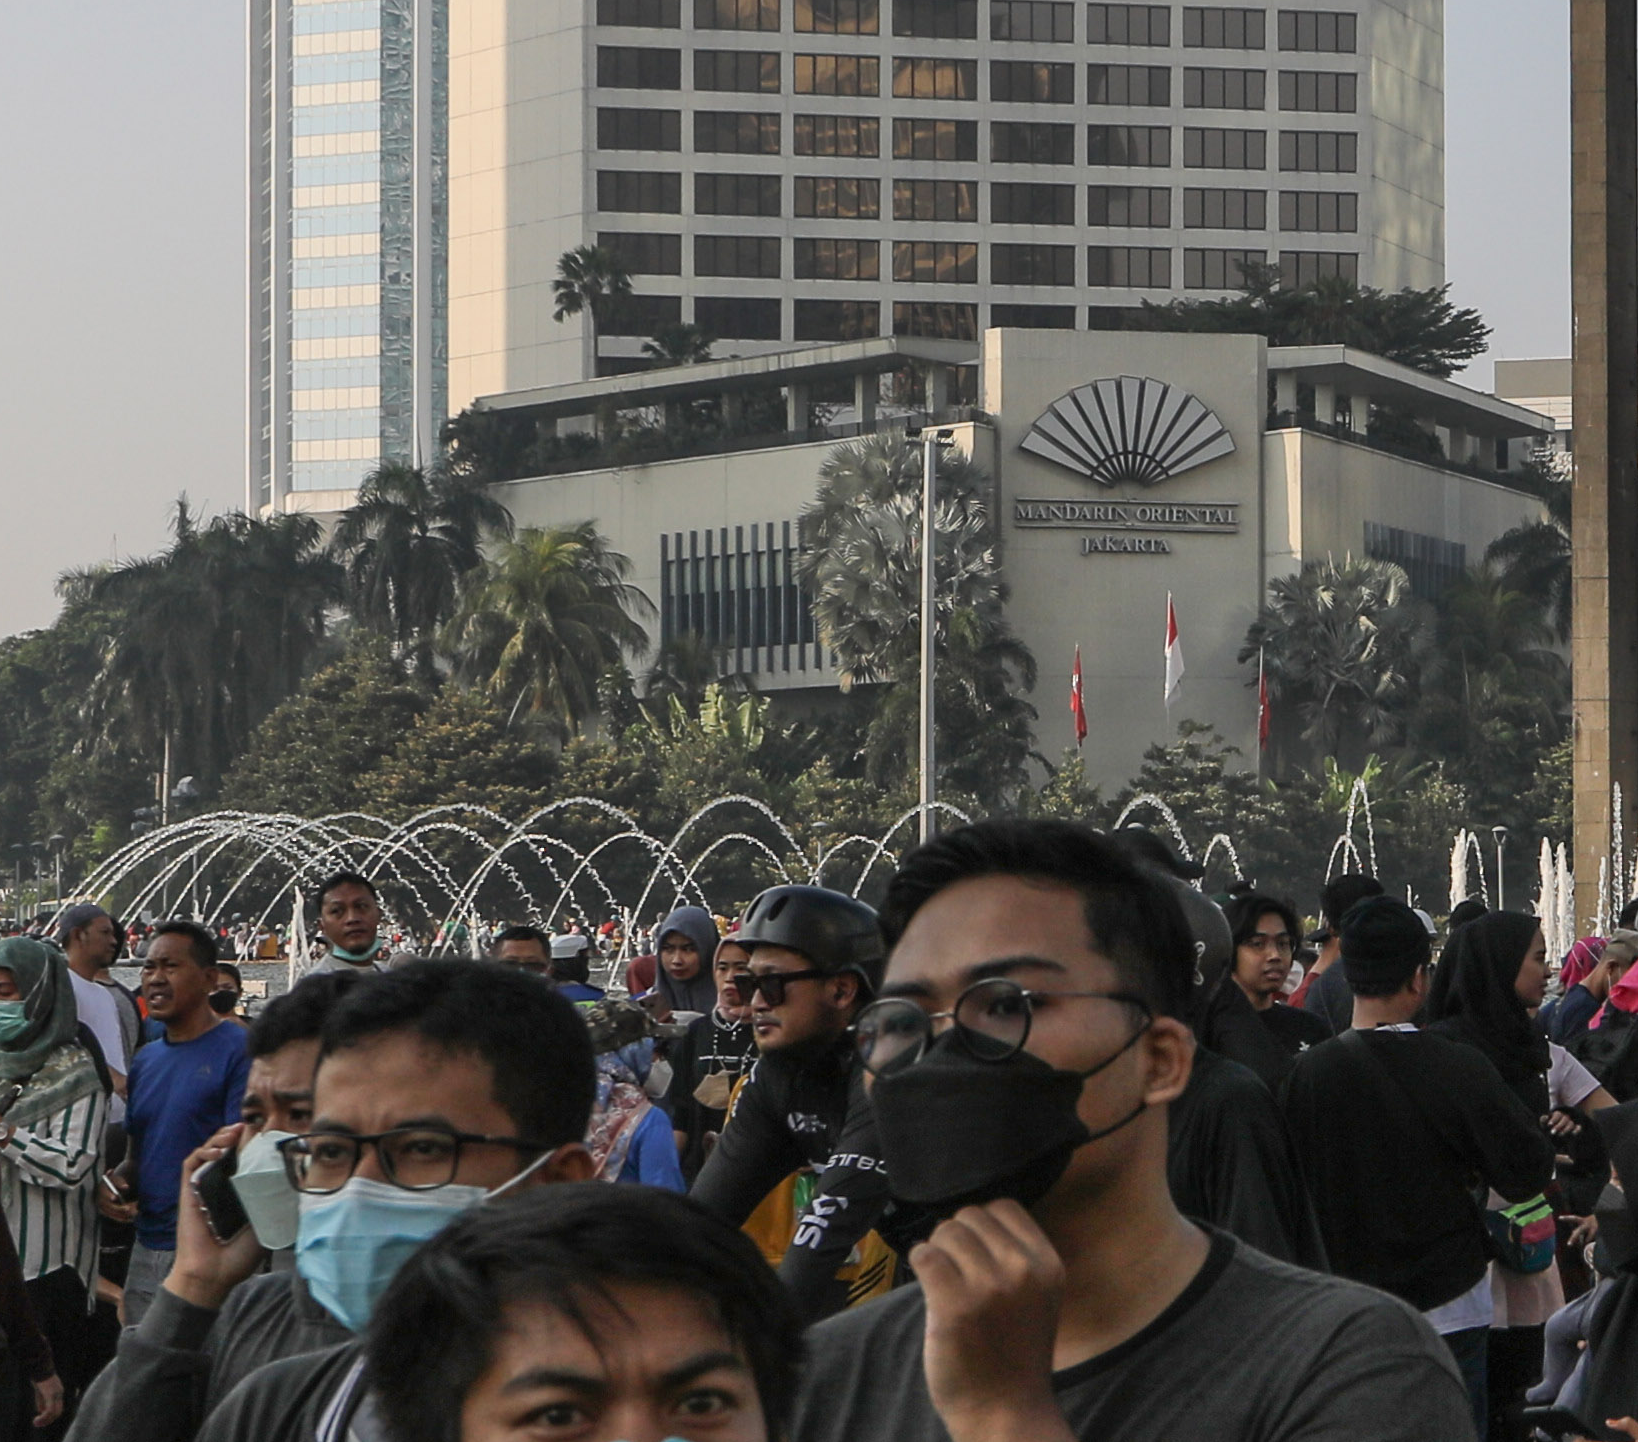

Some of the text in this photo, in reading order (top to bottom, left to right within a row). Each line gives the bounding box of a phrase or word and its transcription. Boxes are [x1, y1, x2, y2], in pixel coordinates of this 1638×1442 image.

[1017, 503, 1240, 525] MANDARIN ORIENTAL
[1081, 534, 1171, 555] JAKARTA
